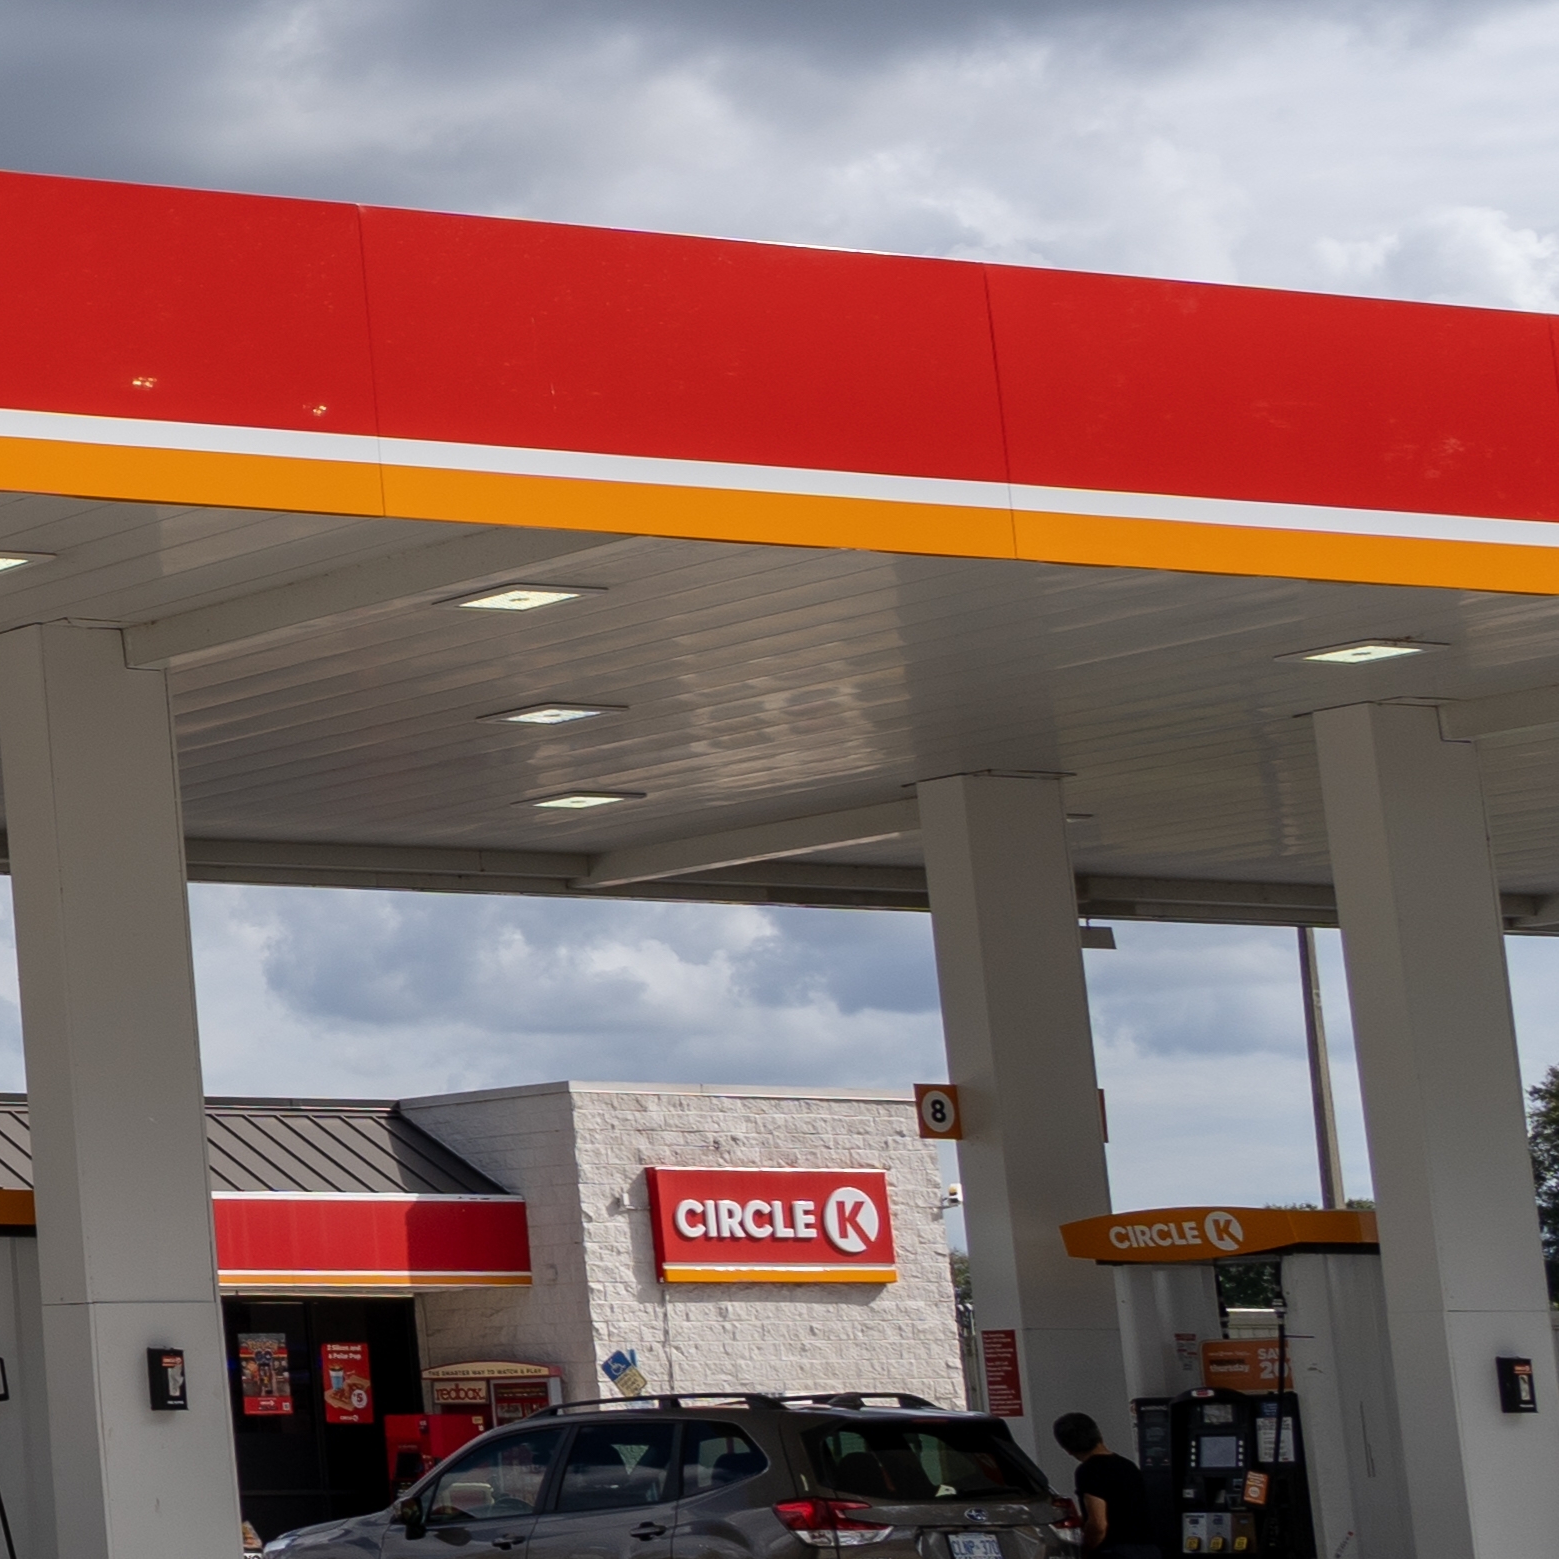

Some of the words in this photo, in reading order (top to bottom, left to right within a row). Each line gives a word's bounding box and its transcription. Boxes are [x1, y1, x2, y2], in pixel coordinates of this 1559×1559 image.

[931, 1099, 946, 1123] 8
[674, 1199, 818, 1239] CIRCLE
[1109, 1221, 1203, 1249] CIRCLE
